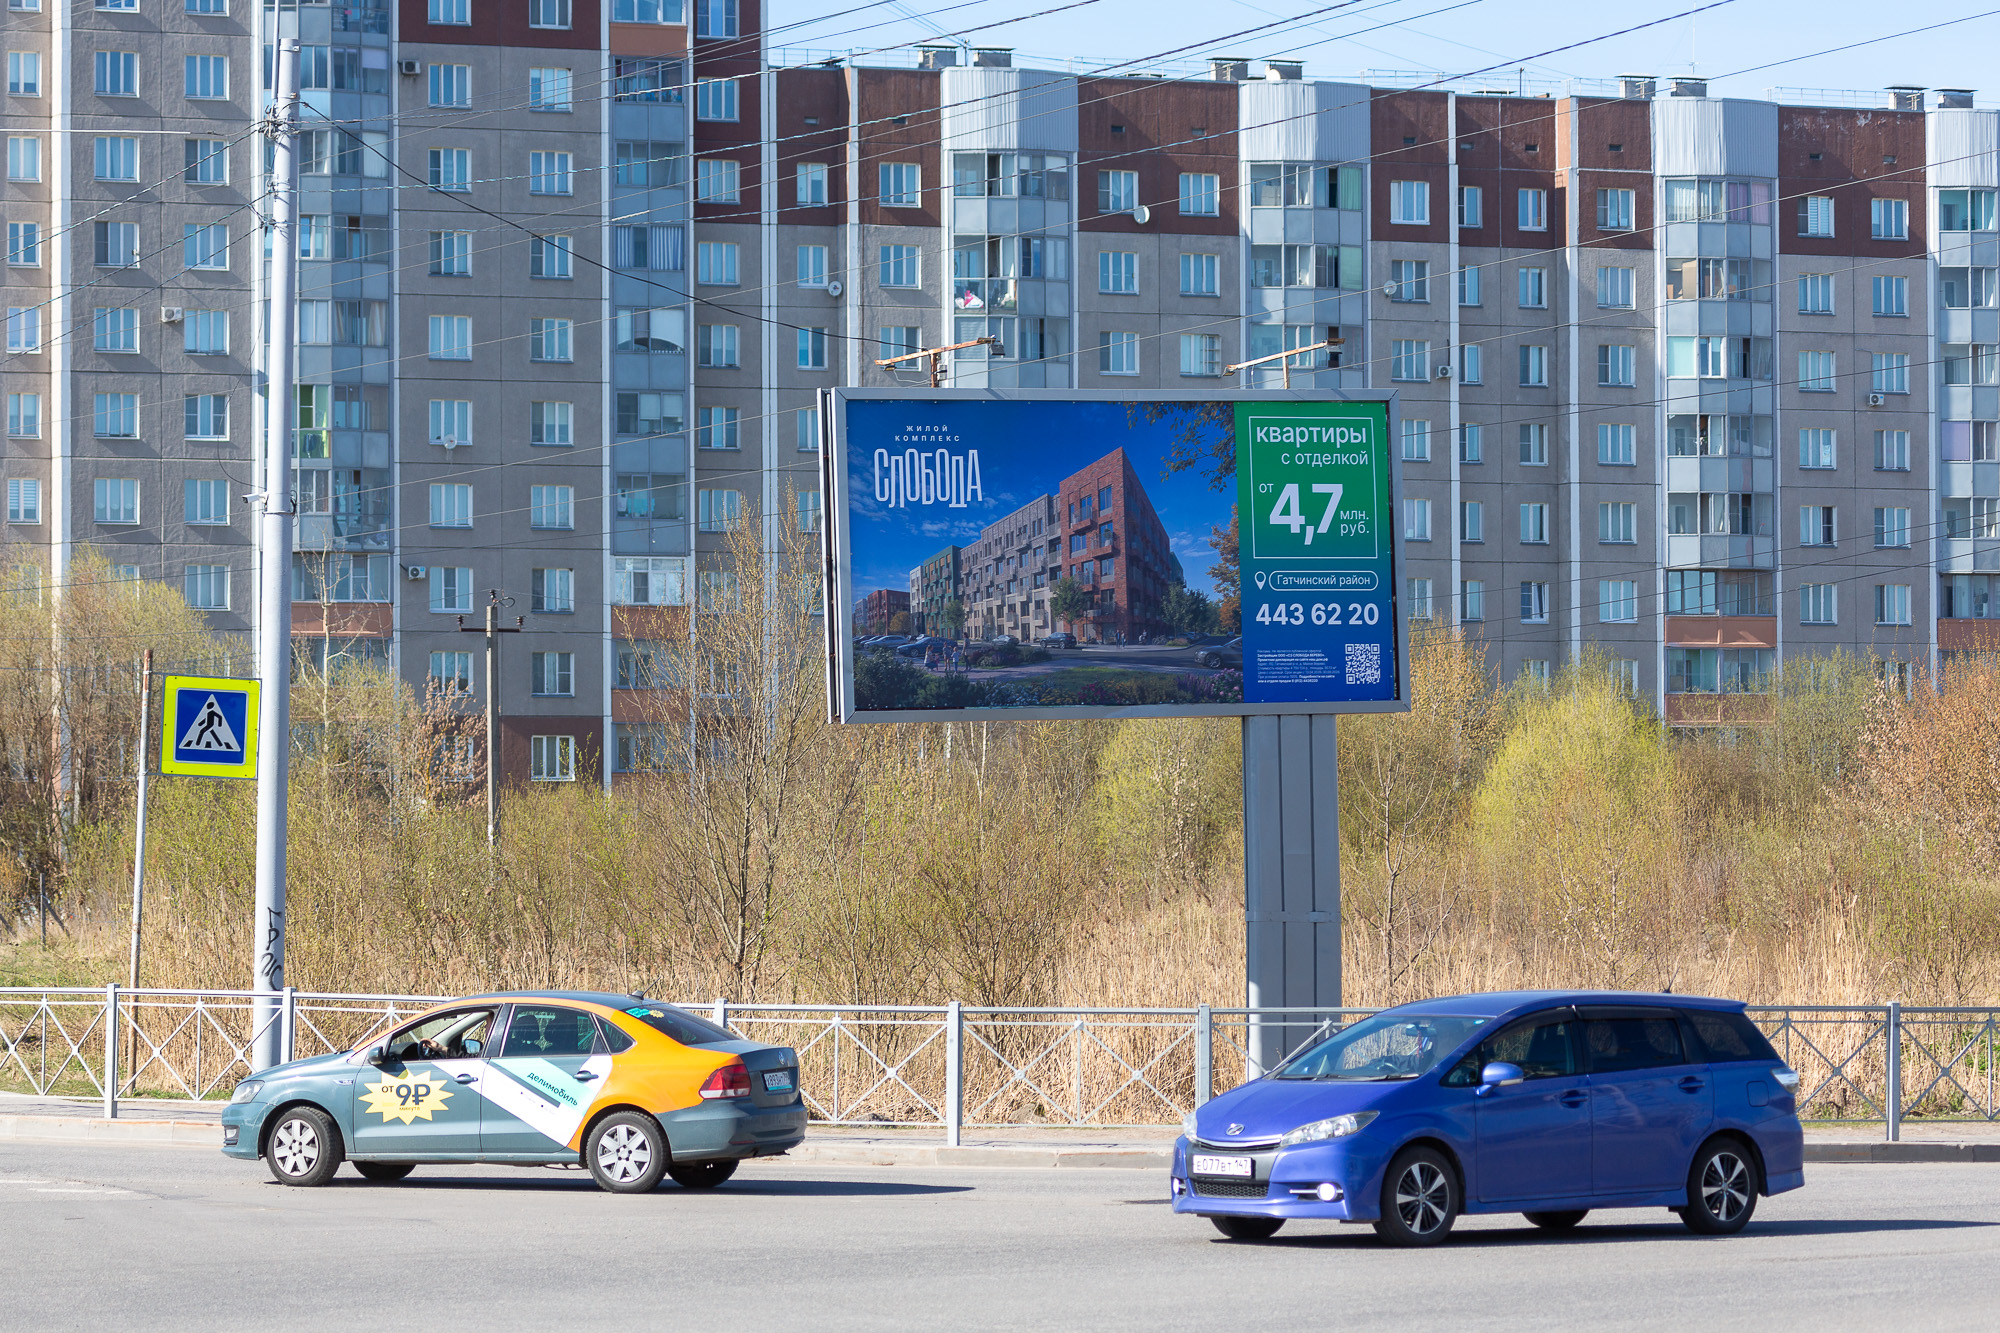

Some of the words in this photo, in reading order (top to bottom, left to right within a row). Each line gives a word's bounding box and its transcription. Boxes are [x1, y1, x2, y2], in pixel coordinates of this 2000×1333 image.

[906, 424, 948, 432] ЖИЛОЙ
[1256, 426, 1366, 448] квартиры
[1281, 453, 1290, 465] с
[1295, 450, 1369, 467] отделкой
[874, 448, 983, 508] СЛОБОДА
[1259, 483, 1274, 493] от
[1269, 483, 1344, 545] 4,7
[1340, 510, 1369, 520] млн.
[1340, 521, 1370, 536] руб.
[1277, 575, 1337, 585] Гатчинский
[1339, 575, 1371, 587] район
[1256, 603, 1305, 625] 443
[1311, 603, 1342, 625] 62
[1348, 603, 1379, 625] 20
[527, 1072, 578, 1106] делимобиль
